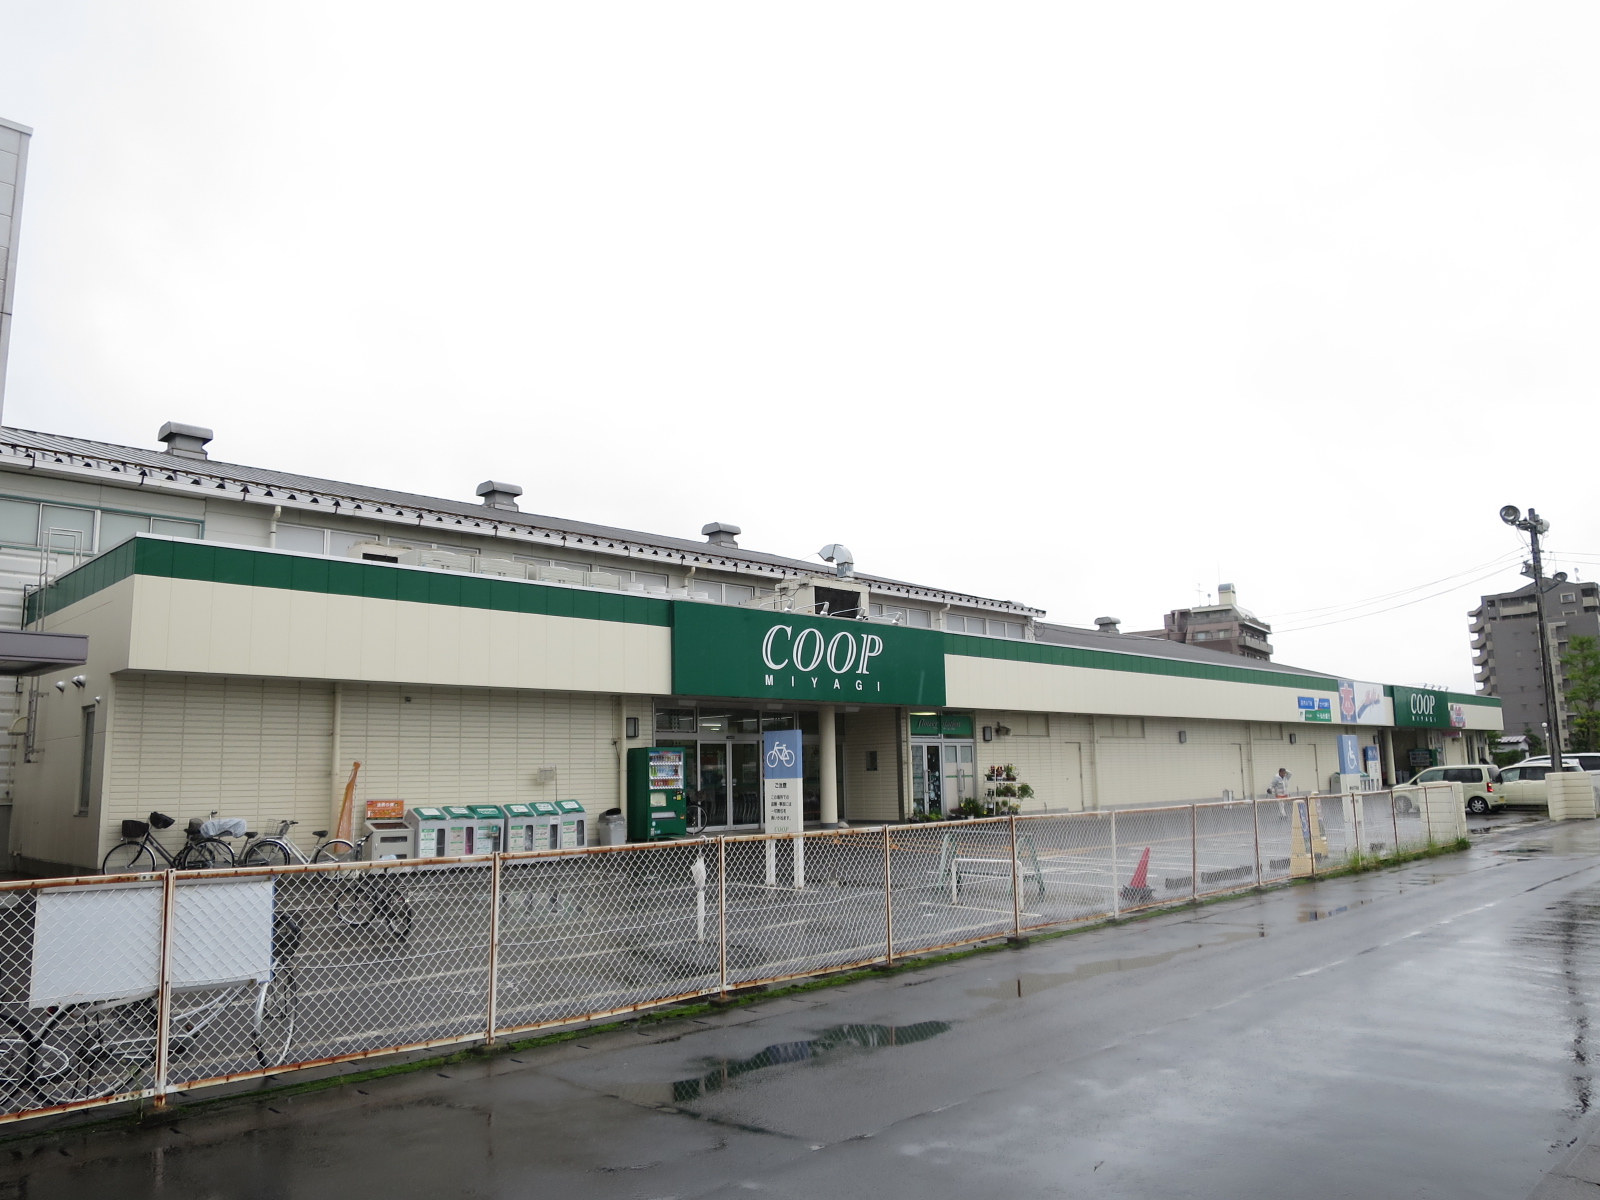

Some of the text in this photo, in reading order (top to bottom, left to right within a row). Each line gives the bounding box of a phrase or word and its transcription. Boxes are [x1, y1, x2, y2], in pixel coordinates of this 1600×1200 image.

[762, 624, 883, 674] COOP
[765, 674, 880, 692] MIYAGI
[1410, 693, 1436, 715] COOP
